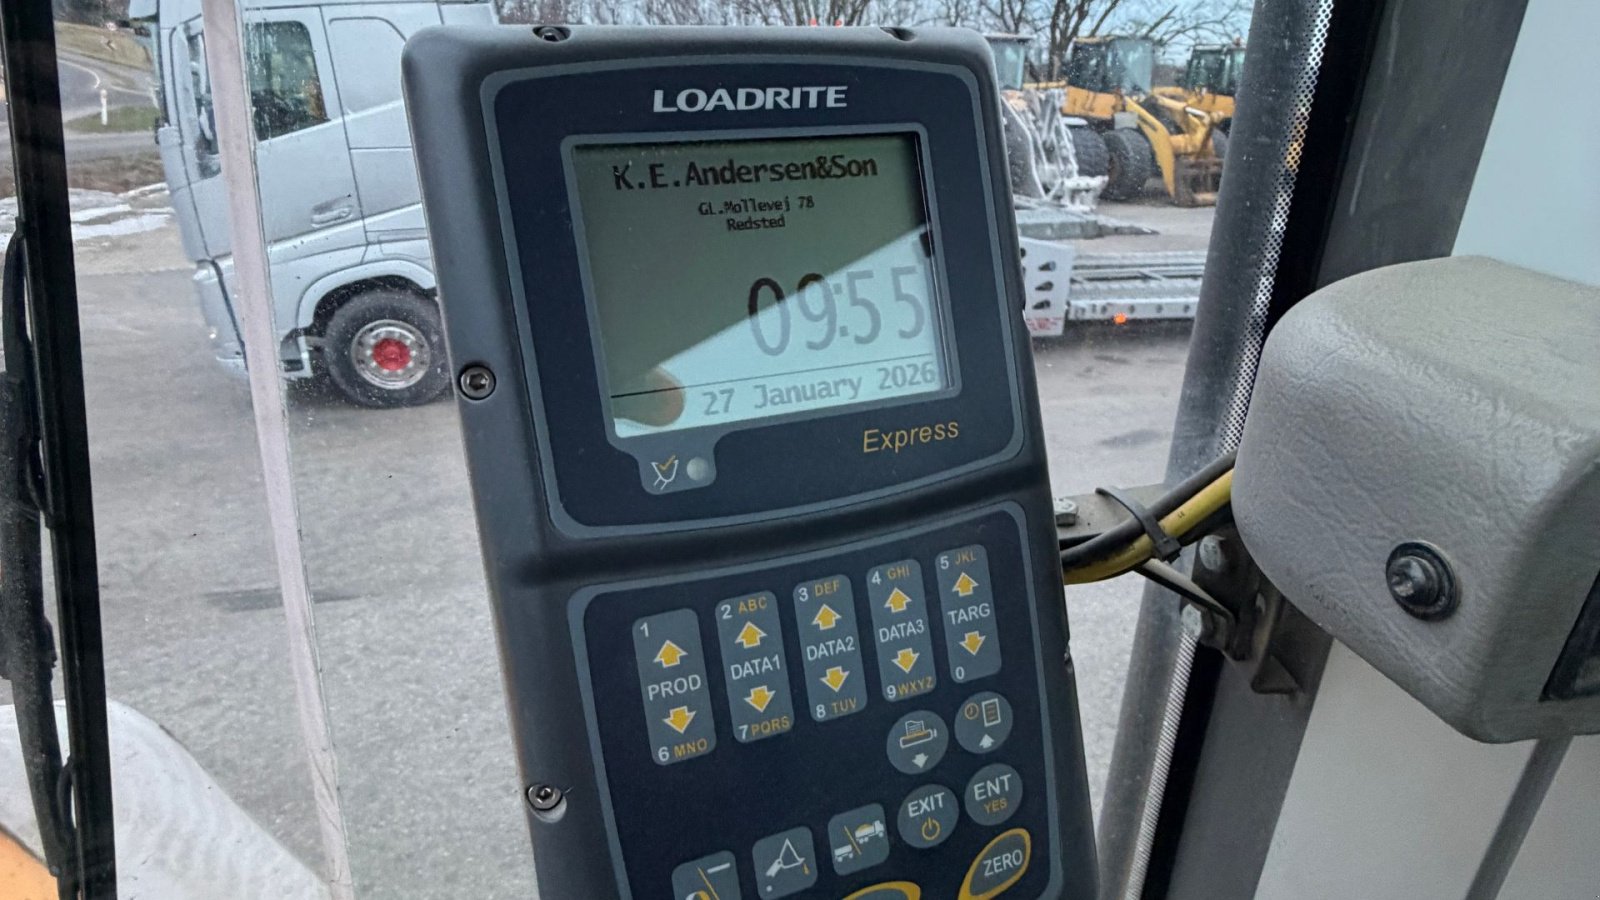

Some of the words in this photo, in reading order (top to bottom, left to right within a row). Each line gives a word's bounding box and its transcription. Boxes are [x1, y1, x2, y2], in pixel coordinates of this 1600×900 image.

[653, 85, 848, 112] LOADRITE
[613, 155, 878, 191] K.E.Andersen&Son
[798, 196, 815, 209] 78
[726, 214, 786, 231] Redsted
[748, 266, 925, 356] 09:55
[703, 389, 735, 415] 27
[754, 375, 862, 409] January
[878, 361, 935, 389] 2026
[862, 420, 959, 454] Express
[940, 556, 949, 569] 5
[954, 552, 977, 565] JKL
[871, 571, 881, 585] 4
[887, 566, 910, 580] GHI
[799, 588, 808, 602] 3
[814, 581, 840, 597] DEF
[721, 604, 732, 619] 2
[738, 596, 767, 615] ABC
[947, 603, 991, 626] TARG
[640, 622, 649, 637] 1
[879, 620, 925, 643] DATA3
[806, 636, 855, 661] DATA2
[730, 654, 780, 680] DATA1
[955, 667, 965, 680] 0
[647, 674, 701, 701] PROD
[886, 685, 897, 699] 9
[898, 676, 934, 696] WXYZ
[816, 704, 826, 718] 8
[831, 698, 857, 714] TUV
[739, 724, 748, 739] 7
[750, 716, 790, 736] PQRS
[658, 746, 669, 762] 6
[674, 739, 708, 758] MNO
[973, 773, 1012, 801] ENT
[908, 793, 945, 817] EXIT
[984, 800, 1008, 814] YES
[983, 850, 1023, 877] ZERO
